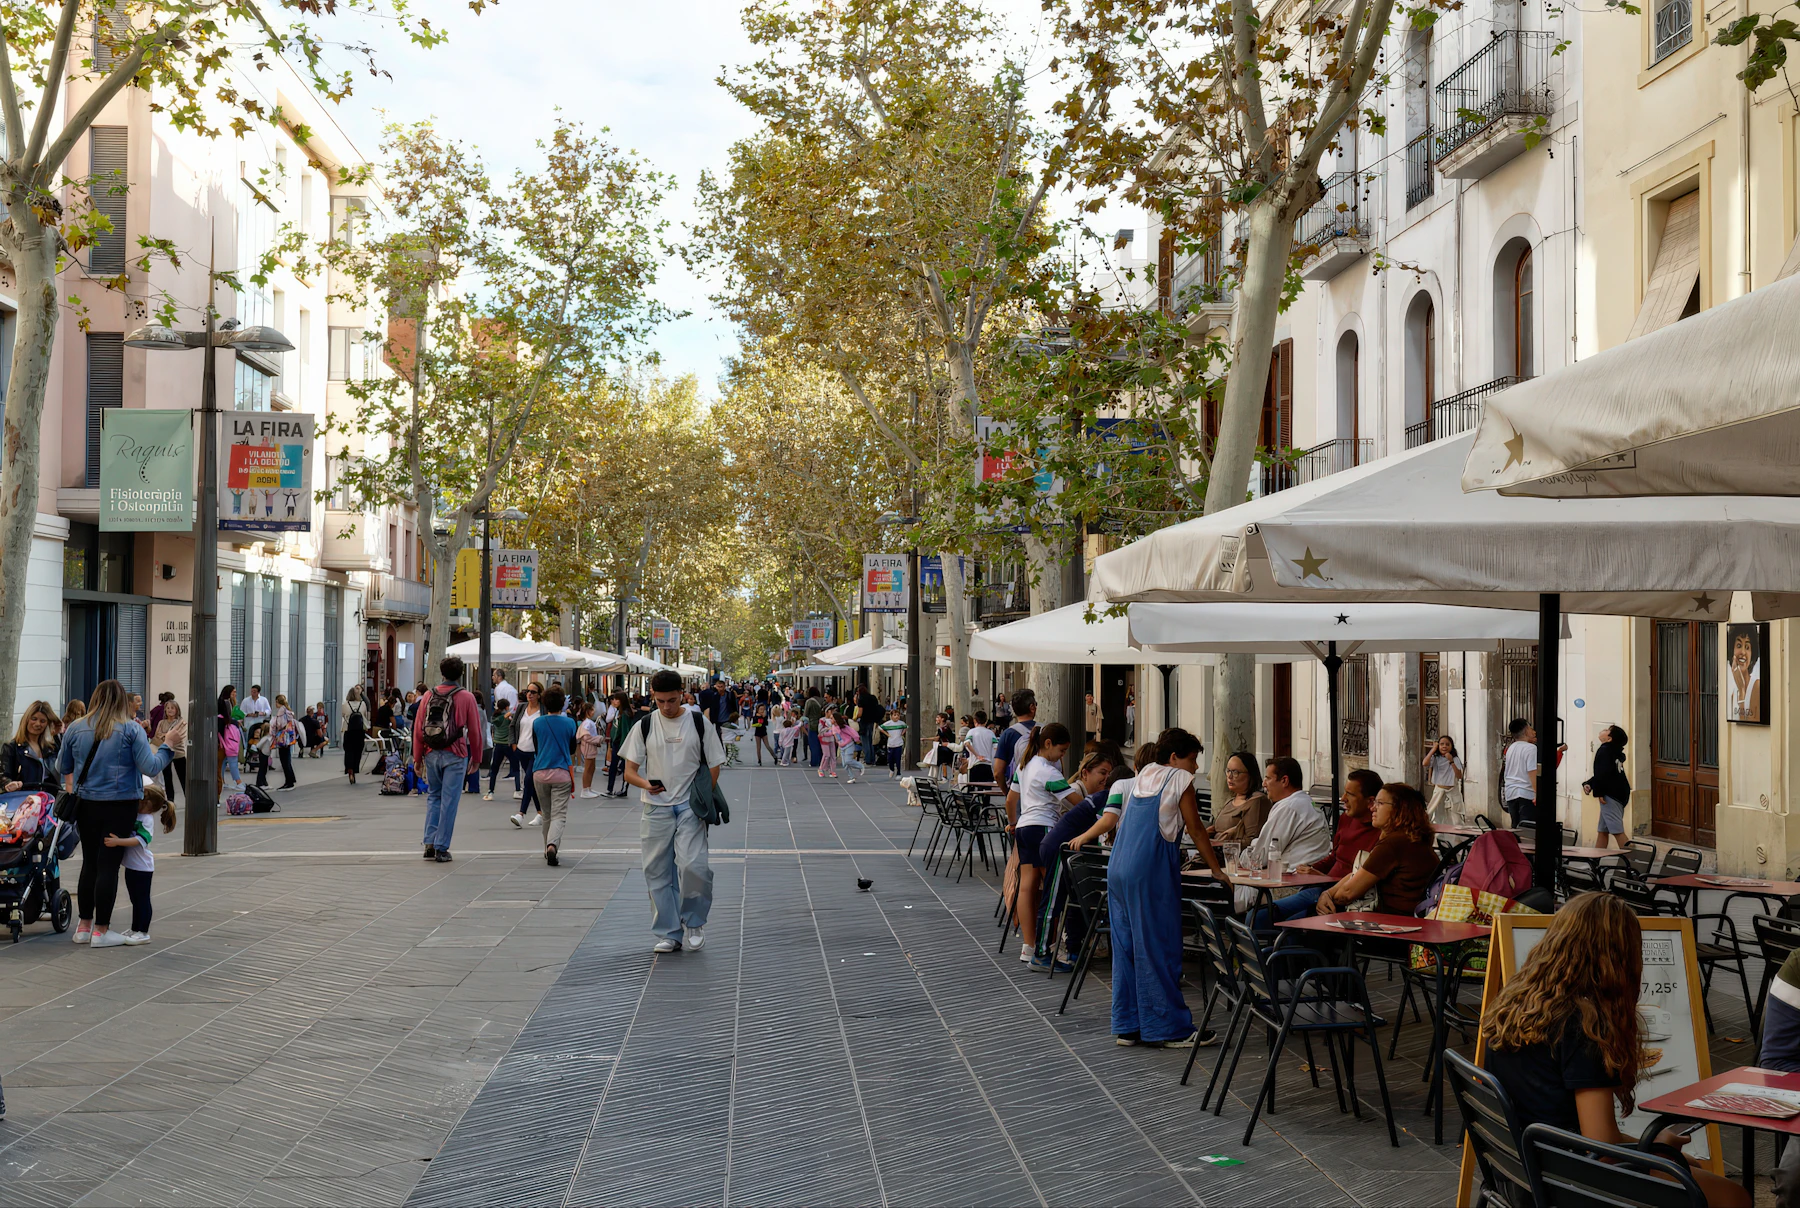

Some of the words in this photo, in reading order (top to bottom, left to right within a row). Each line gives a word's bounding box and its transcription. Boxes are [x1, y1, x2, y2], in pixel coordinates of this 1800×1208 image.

[234, 420, 255, 436] LA
[260, 421, 304, 438] FIRA
[249, 458, 259, 466] LA
[498, 554, 509, 563] LA
[511, 554, 533, 563] FIRA
[869, 559, 879, 567] LA
[881, 559, 902, 567] FIRA
